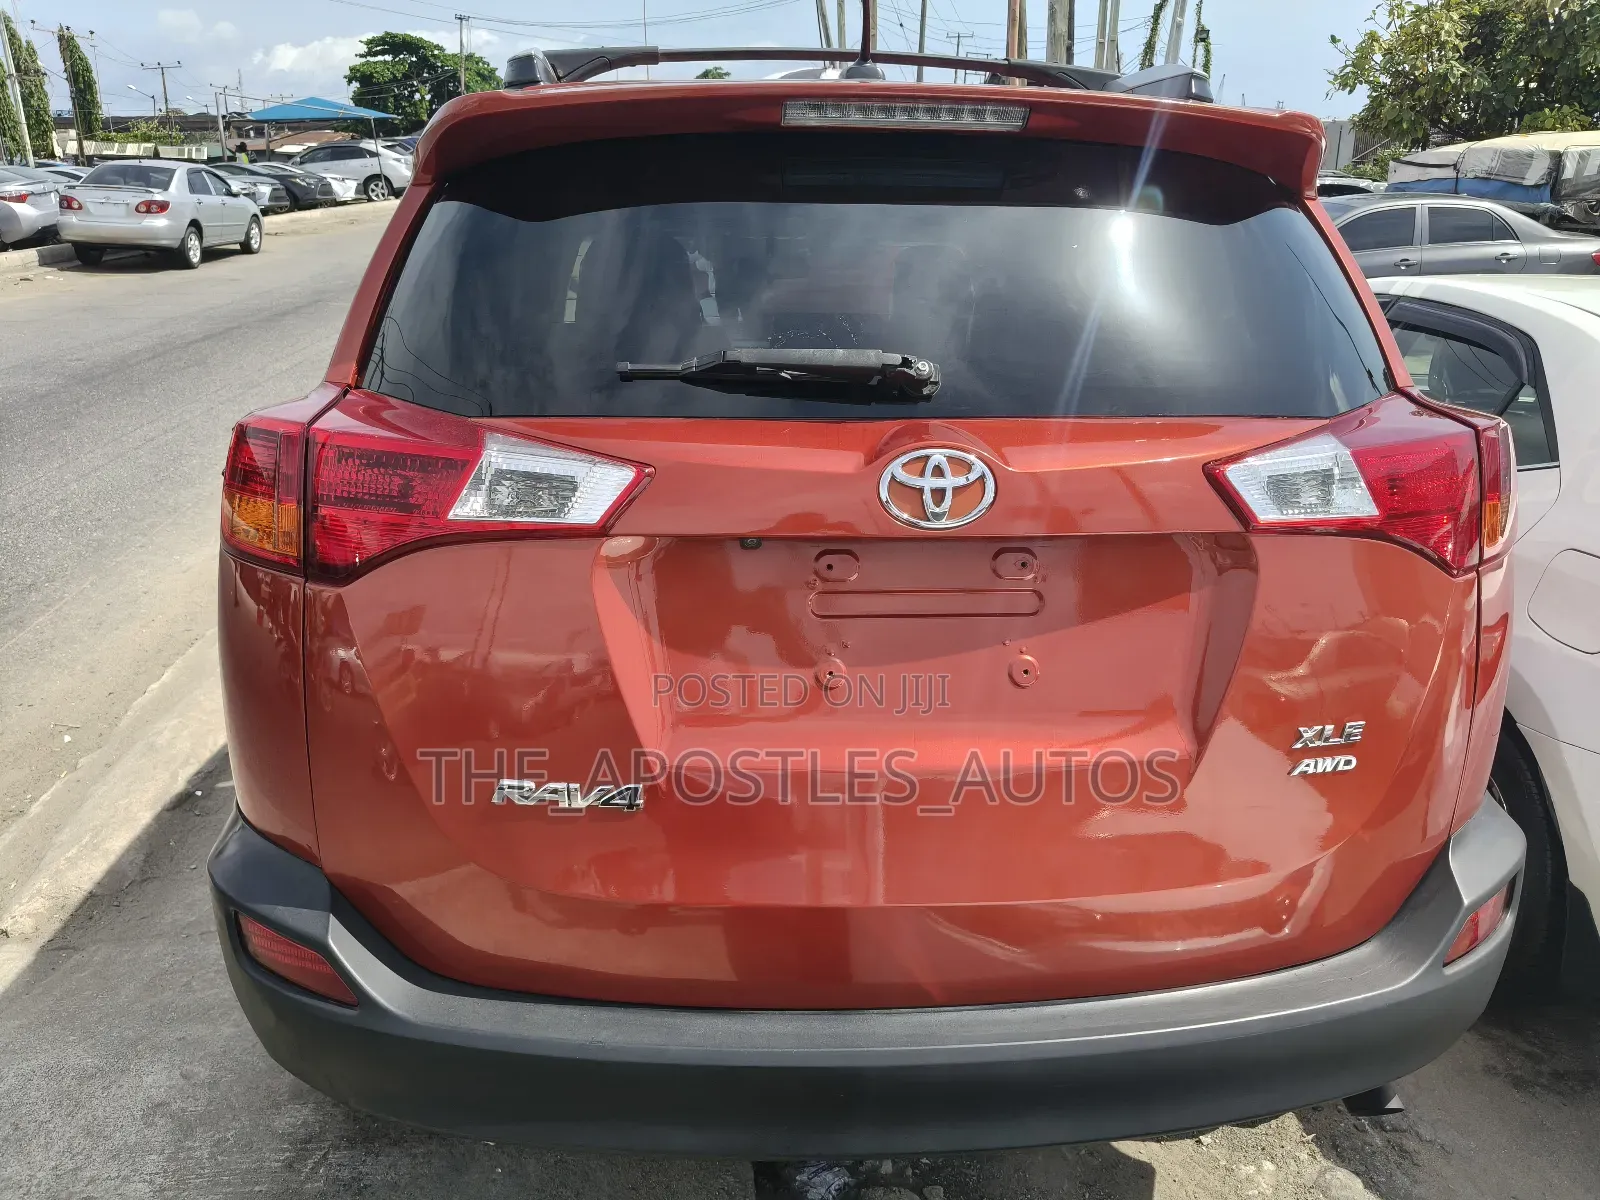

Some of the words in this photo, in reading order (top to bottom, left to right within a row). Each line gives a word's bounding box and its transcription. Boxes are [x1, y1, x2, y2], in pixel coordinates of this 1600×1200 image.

[1291, 720, 1366, 749] XLE
[1288, 754, 1357, 776] AWD
[492, 778, 644, 812] RAV4
